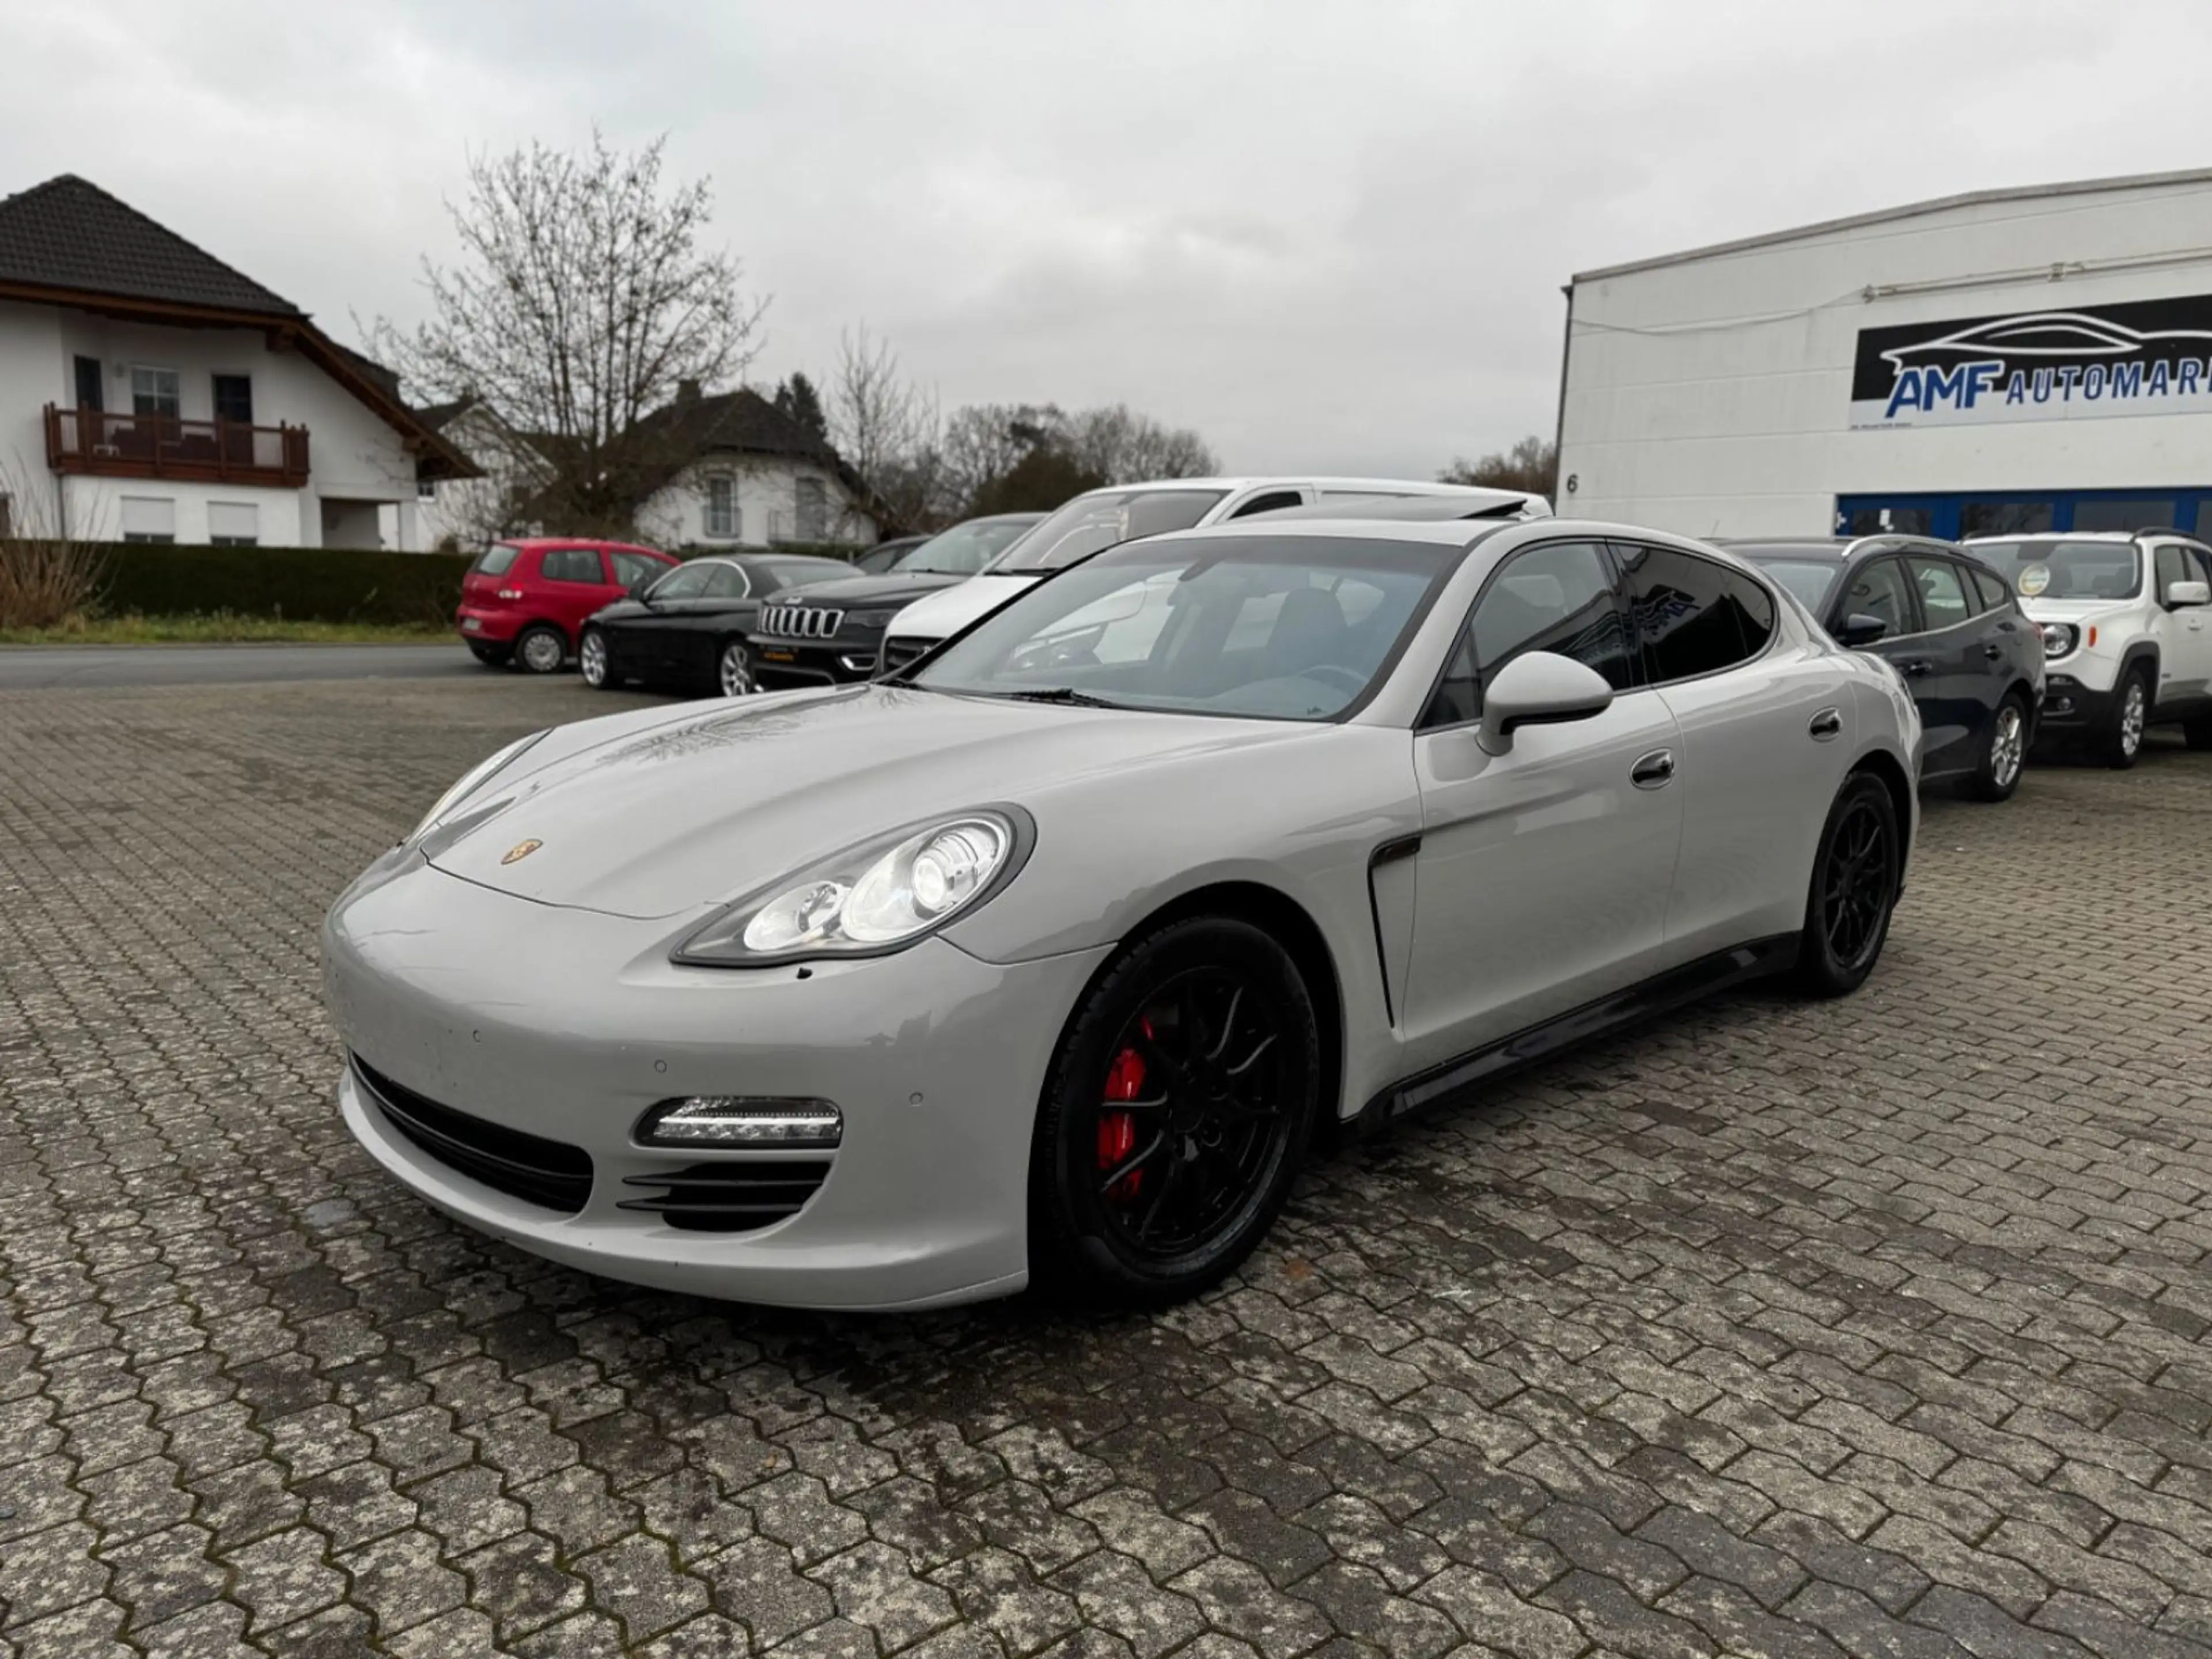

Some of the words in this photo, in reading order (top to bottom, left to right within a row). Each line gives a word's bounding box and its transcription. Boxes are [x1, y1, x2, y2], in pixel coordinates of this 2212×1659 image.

[1884, 362, 2004, 419] AMF
[2005, 357, 2212, 405] AUTOMAR
[1567, 474, 1578, 493] 6
